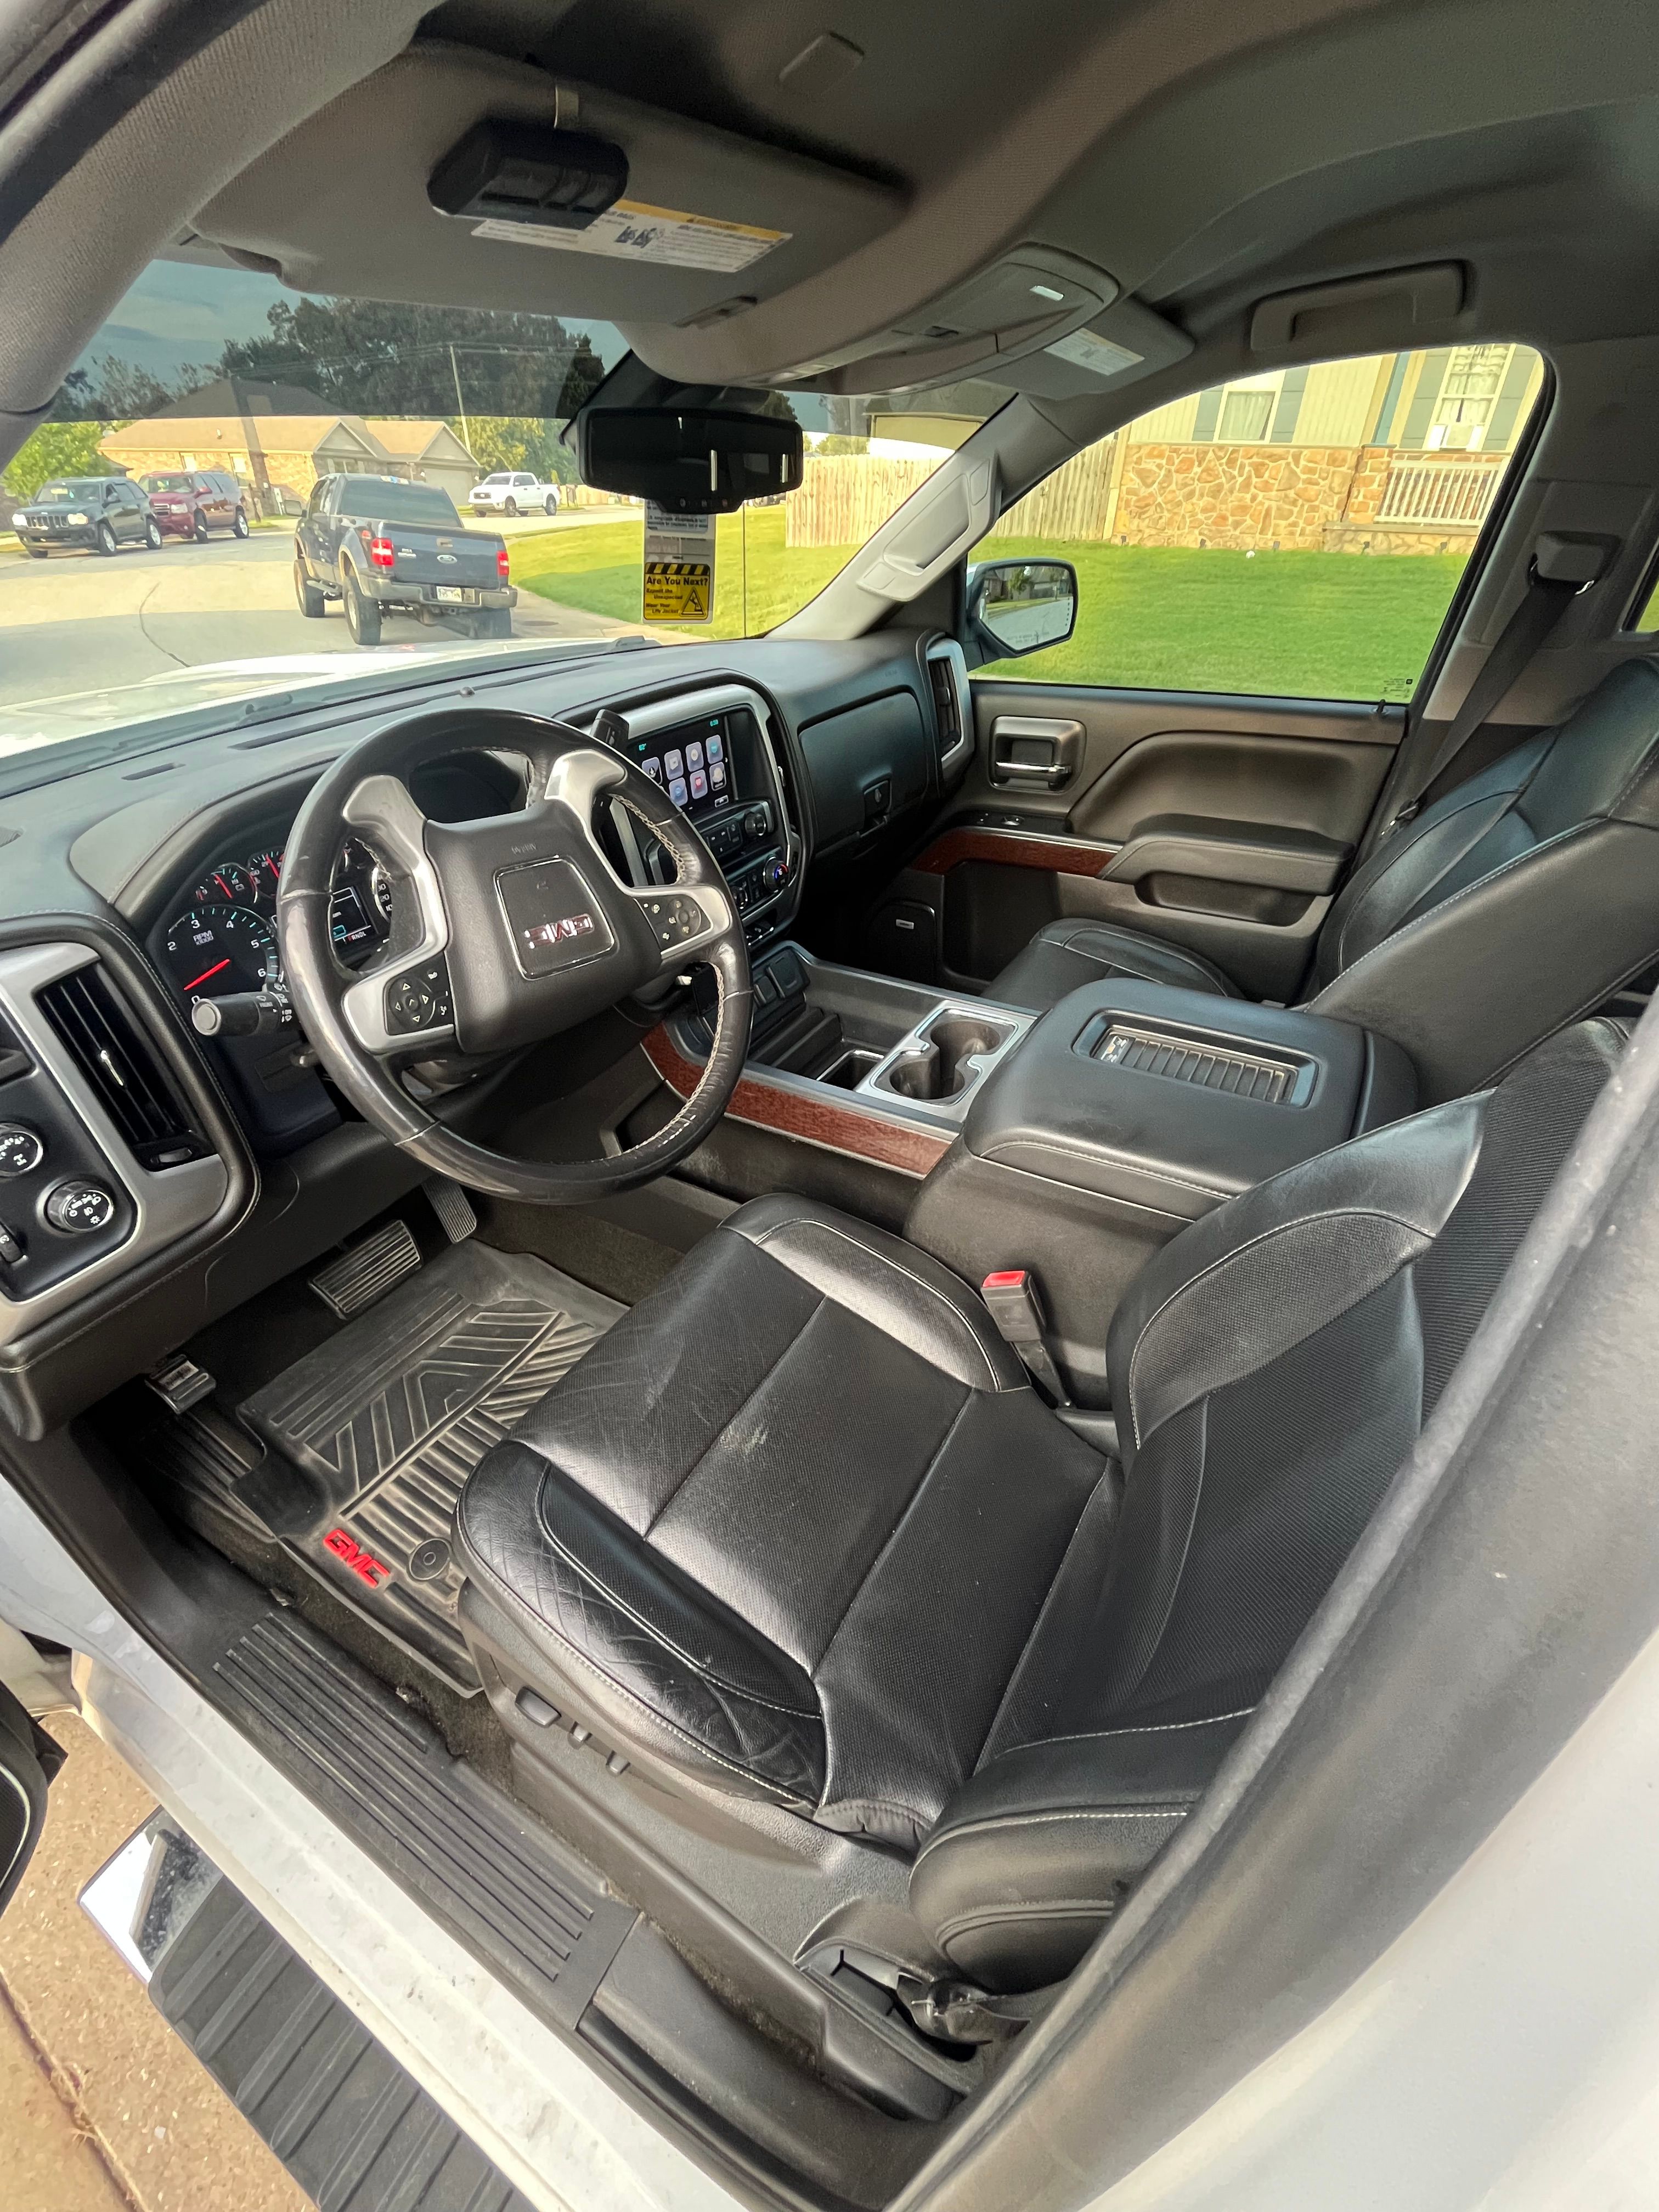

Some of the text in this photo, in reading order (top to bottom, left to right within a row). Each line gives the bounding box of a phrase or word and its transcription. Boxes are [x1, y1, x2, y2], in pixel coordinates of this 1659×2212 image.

[646, 576, 708, 585] Are You Next?
[190, 919, 200, 929] 3
[193, 930, 213, 941] RPM
[524, 913, 595, 949] GMC
[167, 941, 177, 951] 2
[250, 939, 259, 949] 5
[257, 968, 266, 978] 6
[323, 1528, 391, 1589] GMC
